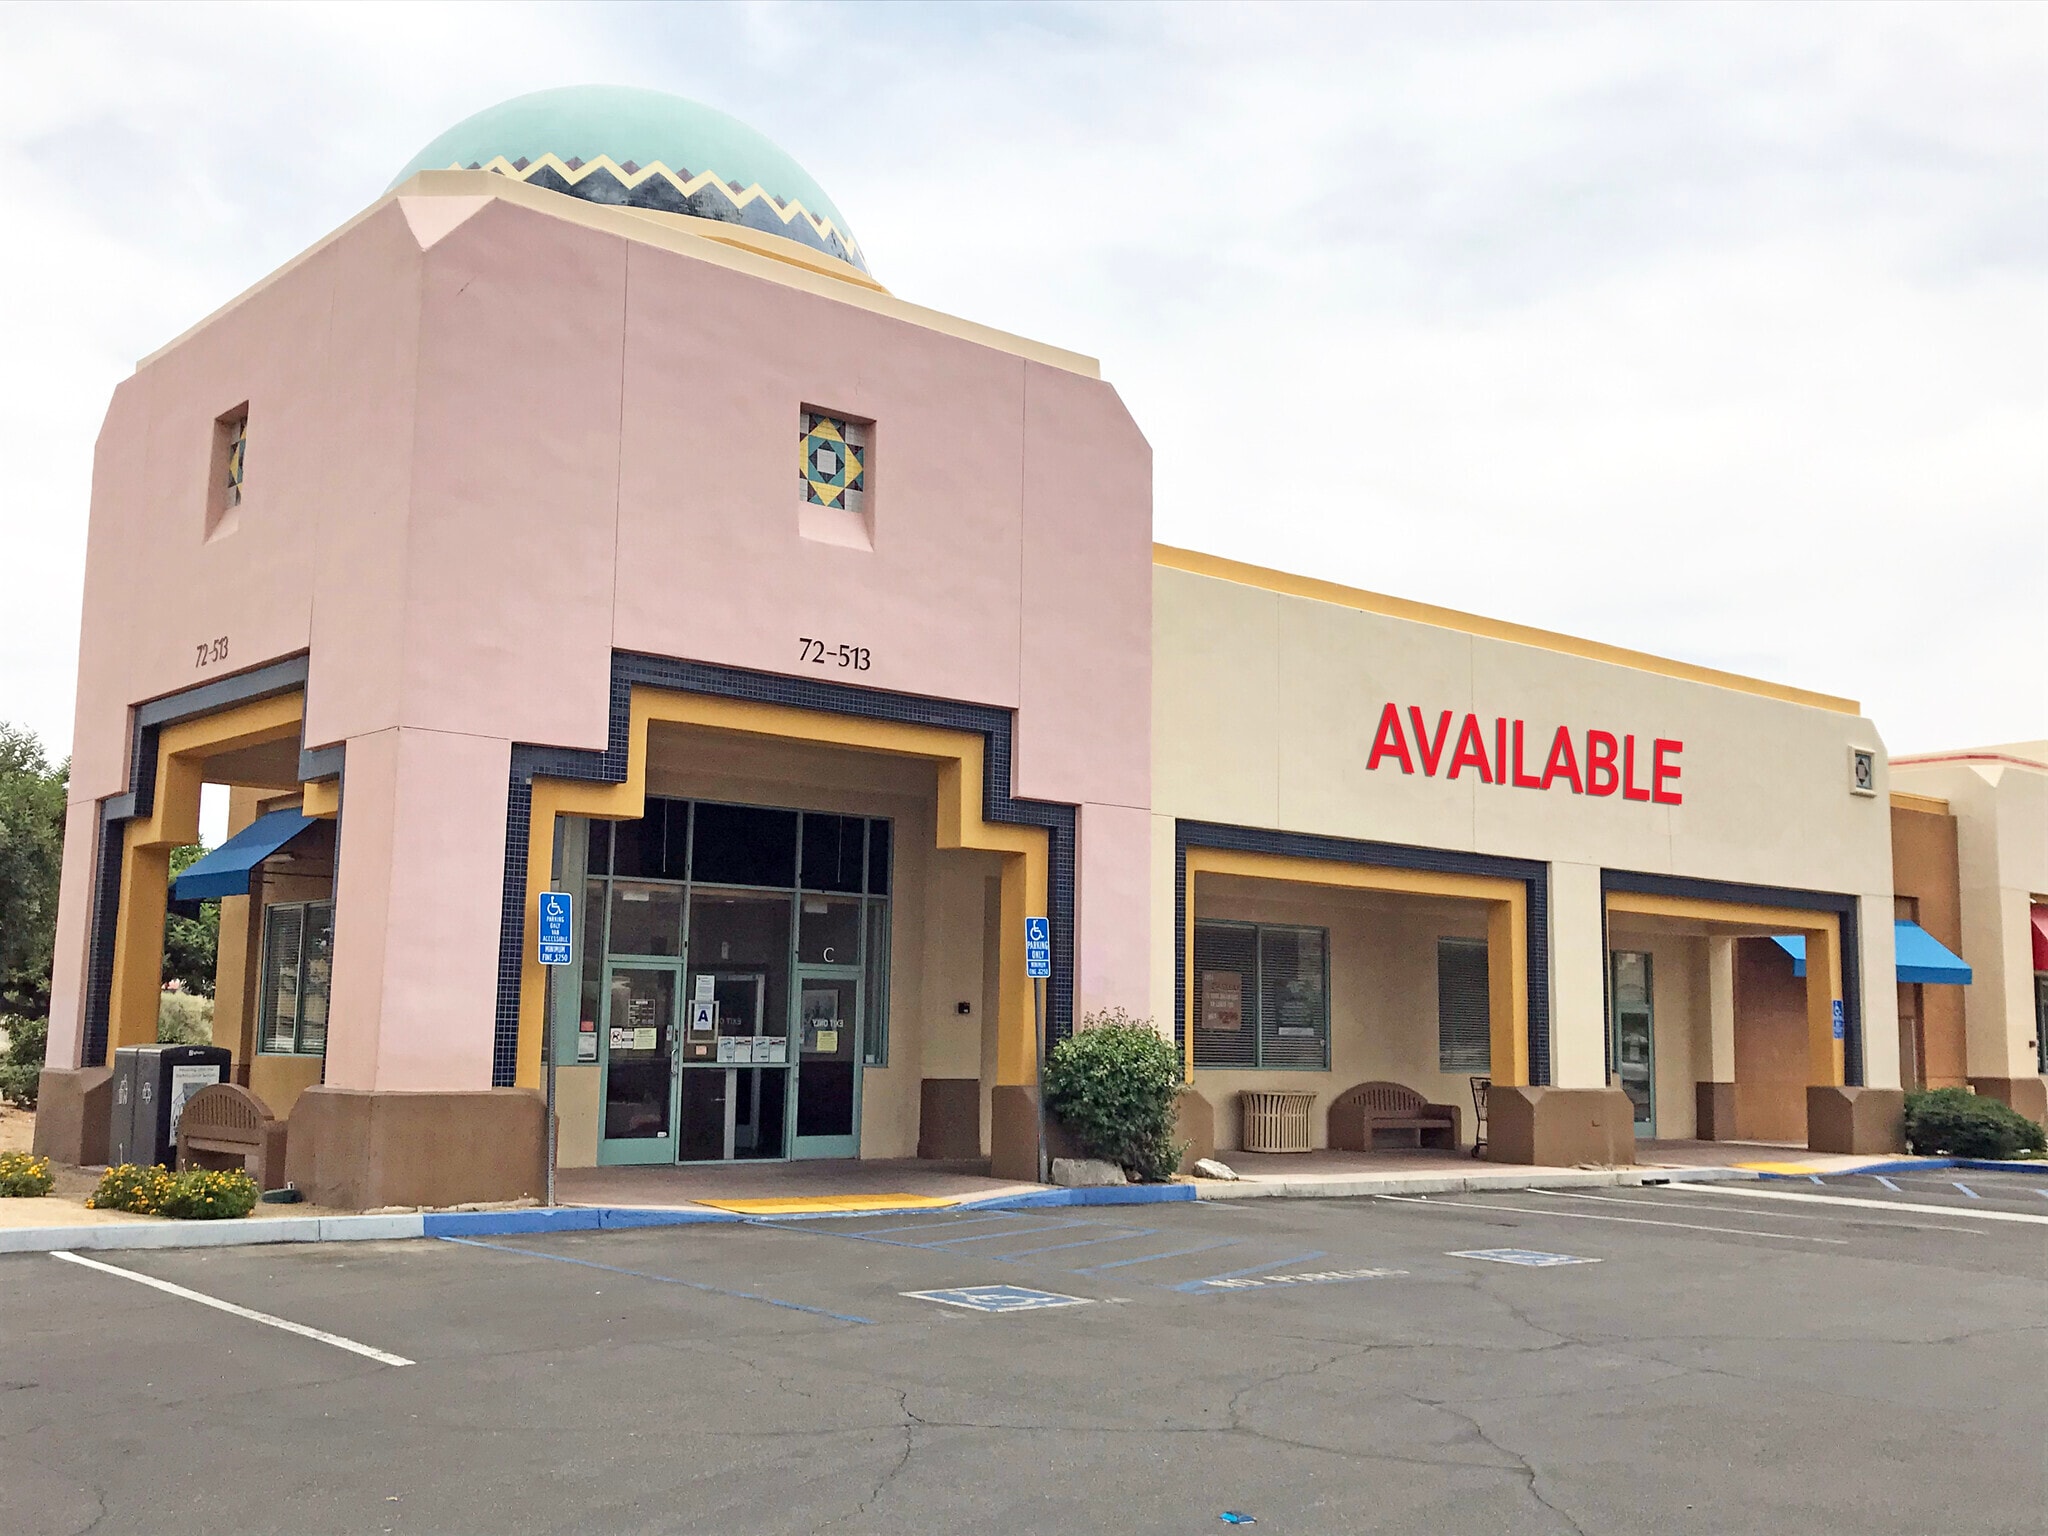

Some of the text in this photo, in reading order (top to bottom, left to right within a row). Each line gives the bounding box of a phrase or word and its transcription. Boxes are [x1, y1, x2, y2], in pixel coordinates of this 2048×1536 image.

[195, 635, 229, 668] 72-513
[799, 637, 871, 671] 72-513
[1027, 941, 1049, 950] PARKING
[823, 947, 835, 963] C
[1032, 950, 1044, 959] ONLY
[697, 1010, 709, 1022] A
